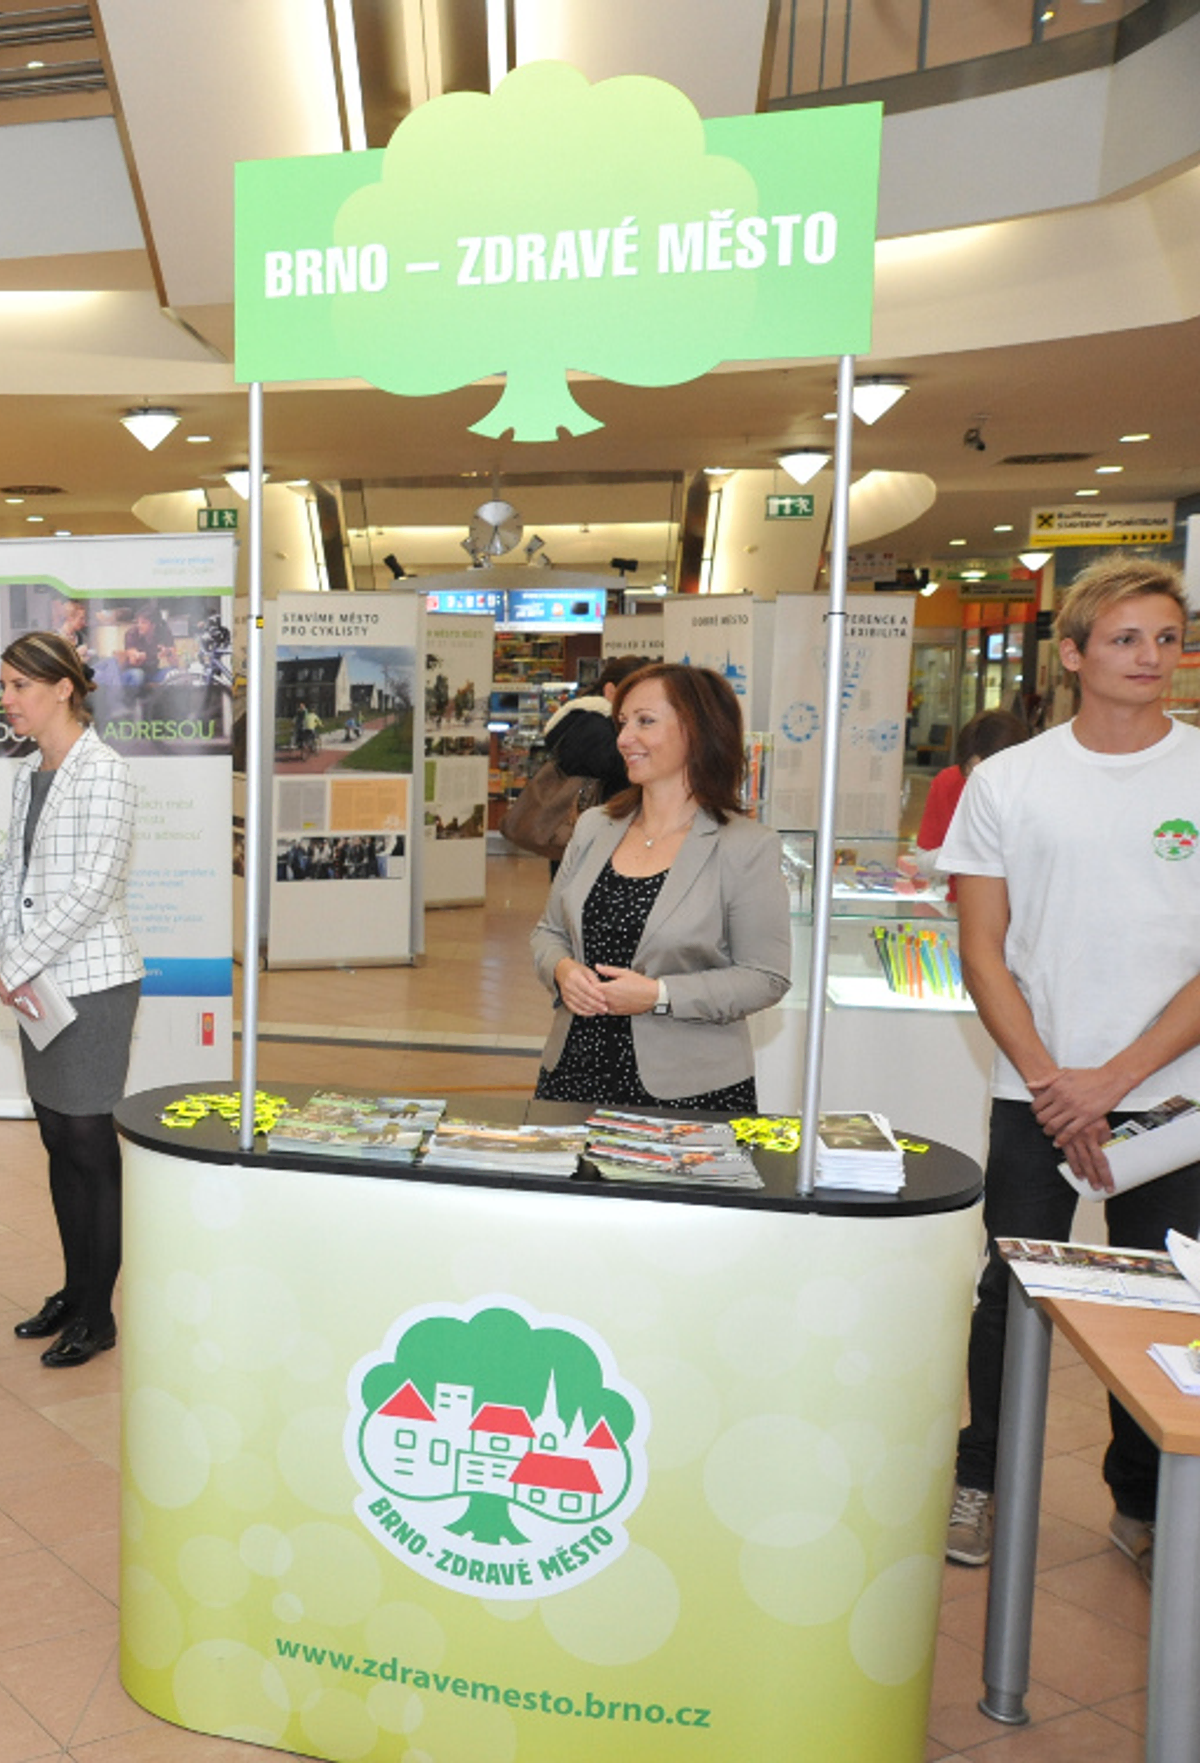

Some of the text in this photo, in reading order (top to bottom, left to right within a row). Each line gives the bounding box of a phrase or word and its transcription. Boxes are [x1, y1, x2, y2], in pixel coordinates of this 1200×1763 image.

[264, 243, 388, 299] BRNO
[456, 216, 638, 286] ZDRAVÉ
[657, 208, 838, 274] MĚSTO
[281, 626, 369, 637] PRO CYKLISTY
[103, 719, 216, 741] ADRESOU
[537, 1525, 614, 1581] MĚSTO
[275, 1637, 712, 1729] www.zdravemesto.brno.cz
